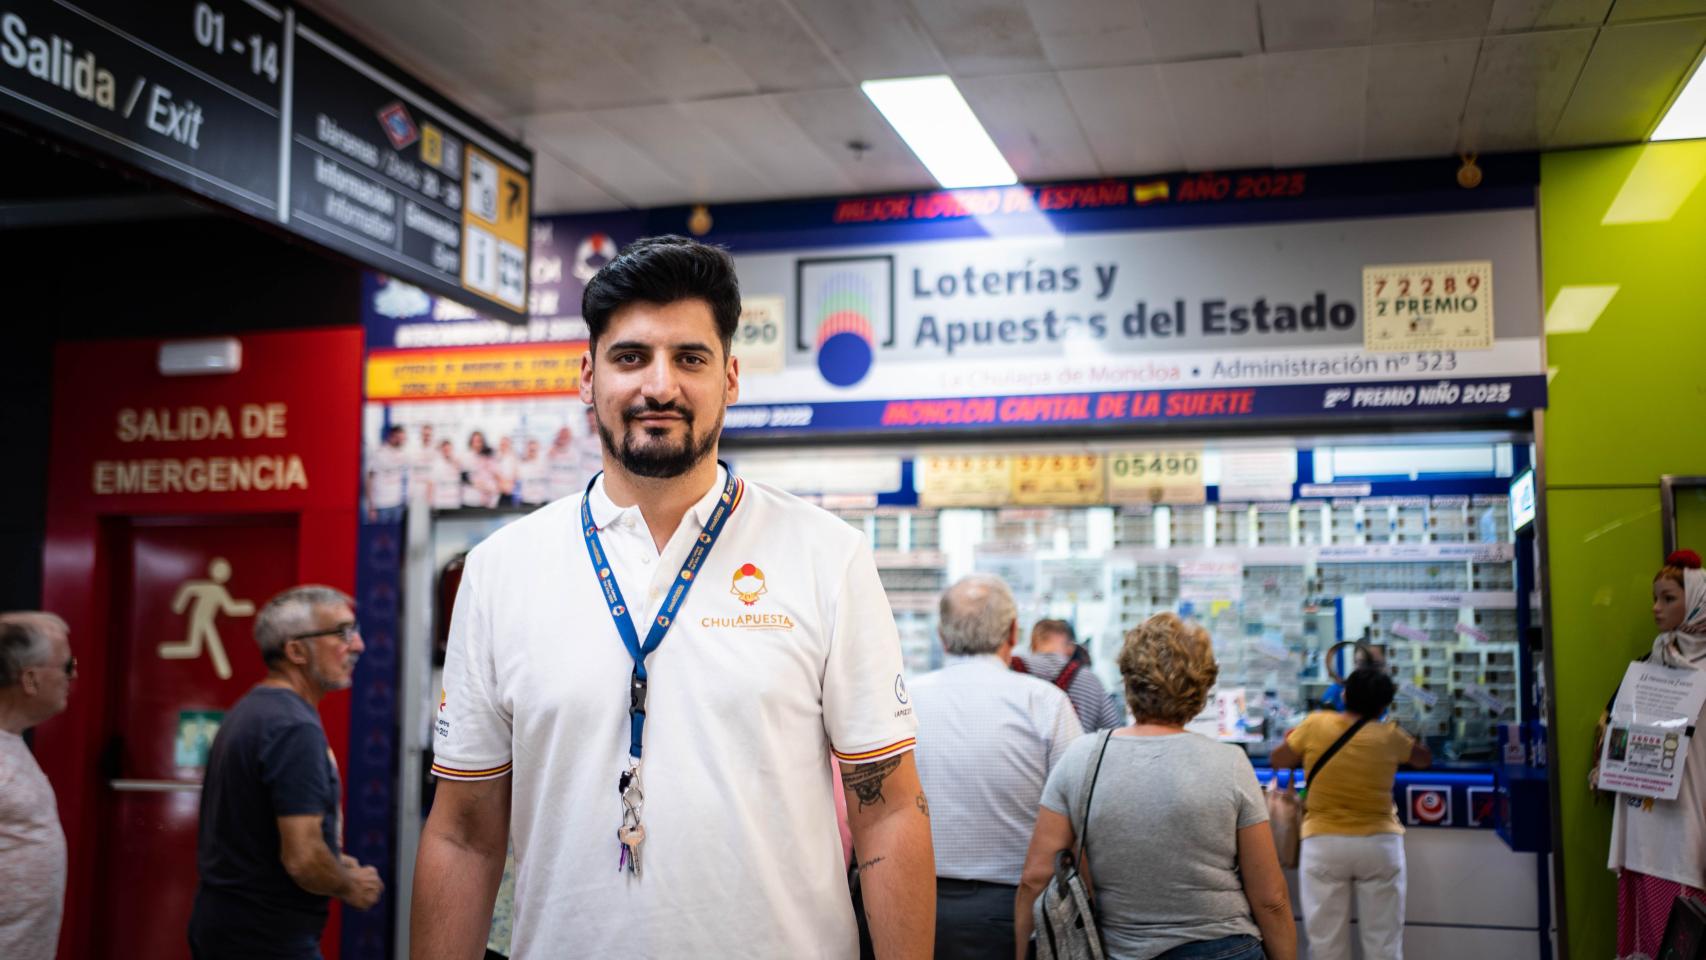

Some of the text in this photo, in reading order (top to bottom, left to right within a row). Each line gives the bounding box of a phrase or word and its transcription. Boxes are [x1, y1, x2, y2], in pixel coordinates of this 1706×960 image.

[194, 2, 225, 54] 01
[250, 35, 278, 83] 14
[0, 12, 116, 111] Salida
[146, 84, 204, 150] Exit
[912, 257, 1119, 299] Loterías y
[1122, 301, 1186, 338] del
[1201, 291, 1357, 336] Estado
[1376, 295, 1478, 317] 2 PREMIO
[1211, 354, 1378, 380] Administración
[1385, 352, 1409, 369] nº
[1416, 349, 1458, 371] 523
[1352, 384, 1416, 408] PREMIO
[1417, 380, 1461, 405] NIÑO
[1461, 383, 1512, 404] 2023
[116, 402, 288, 442] SALIDA DE
[92, 453, 309, 494] EMERGENCIA
[1114, 456, 1199, 477] 05490
[701, 614, 794, 628] CHULAPUESTA
